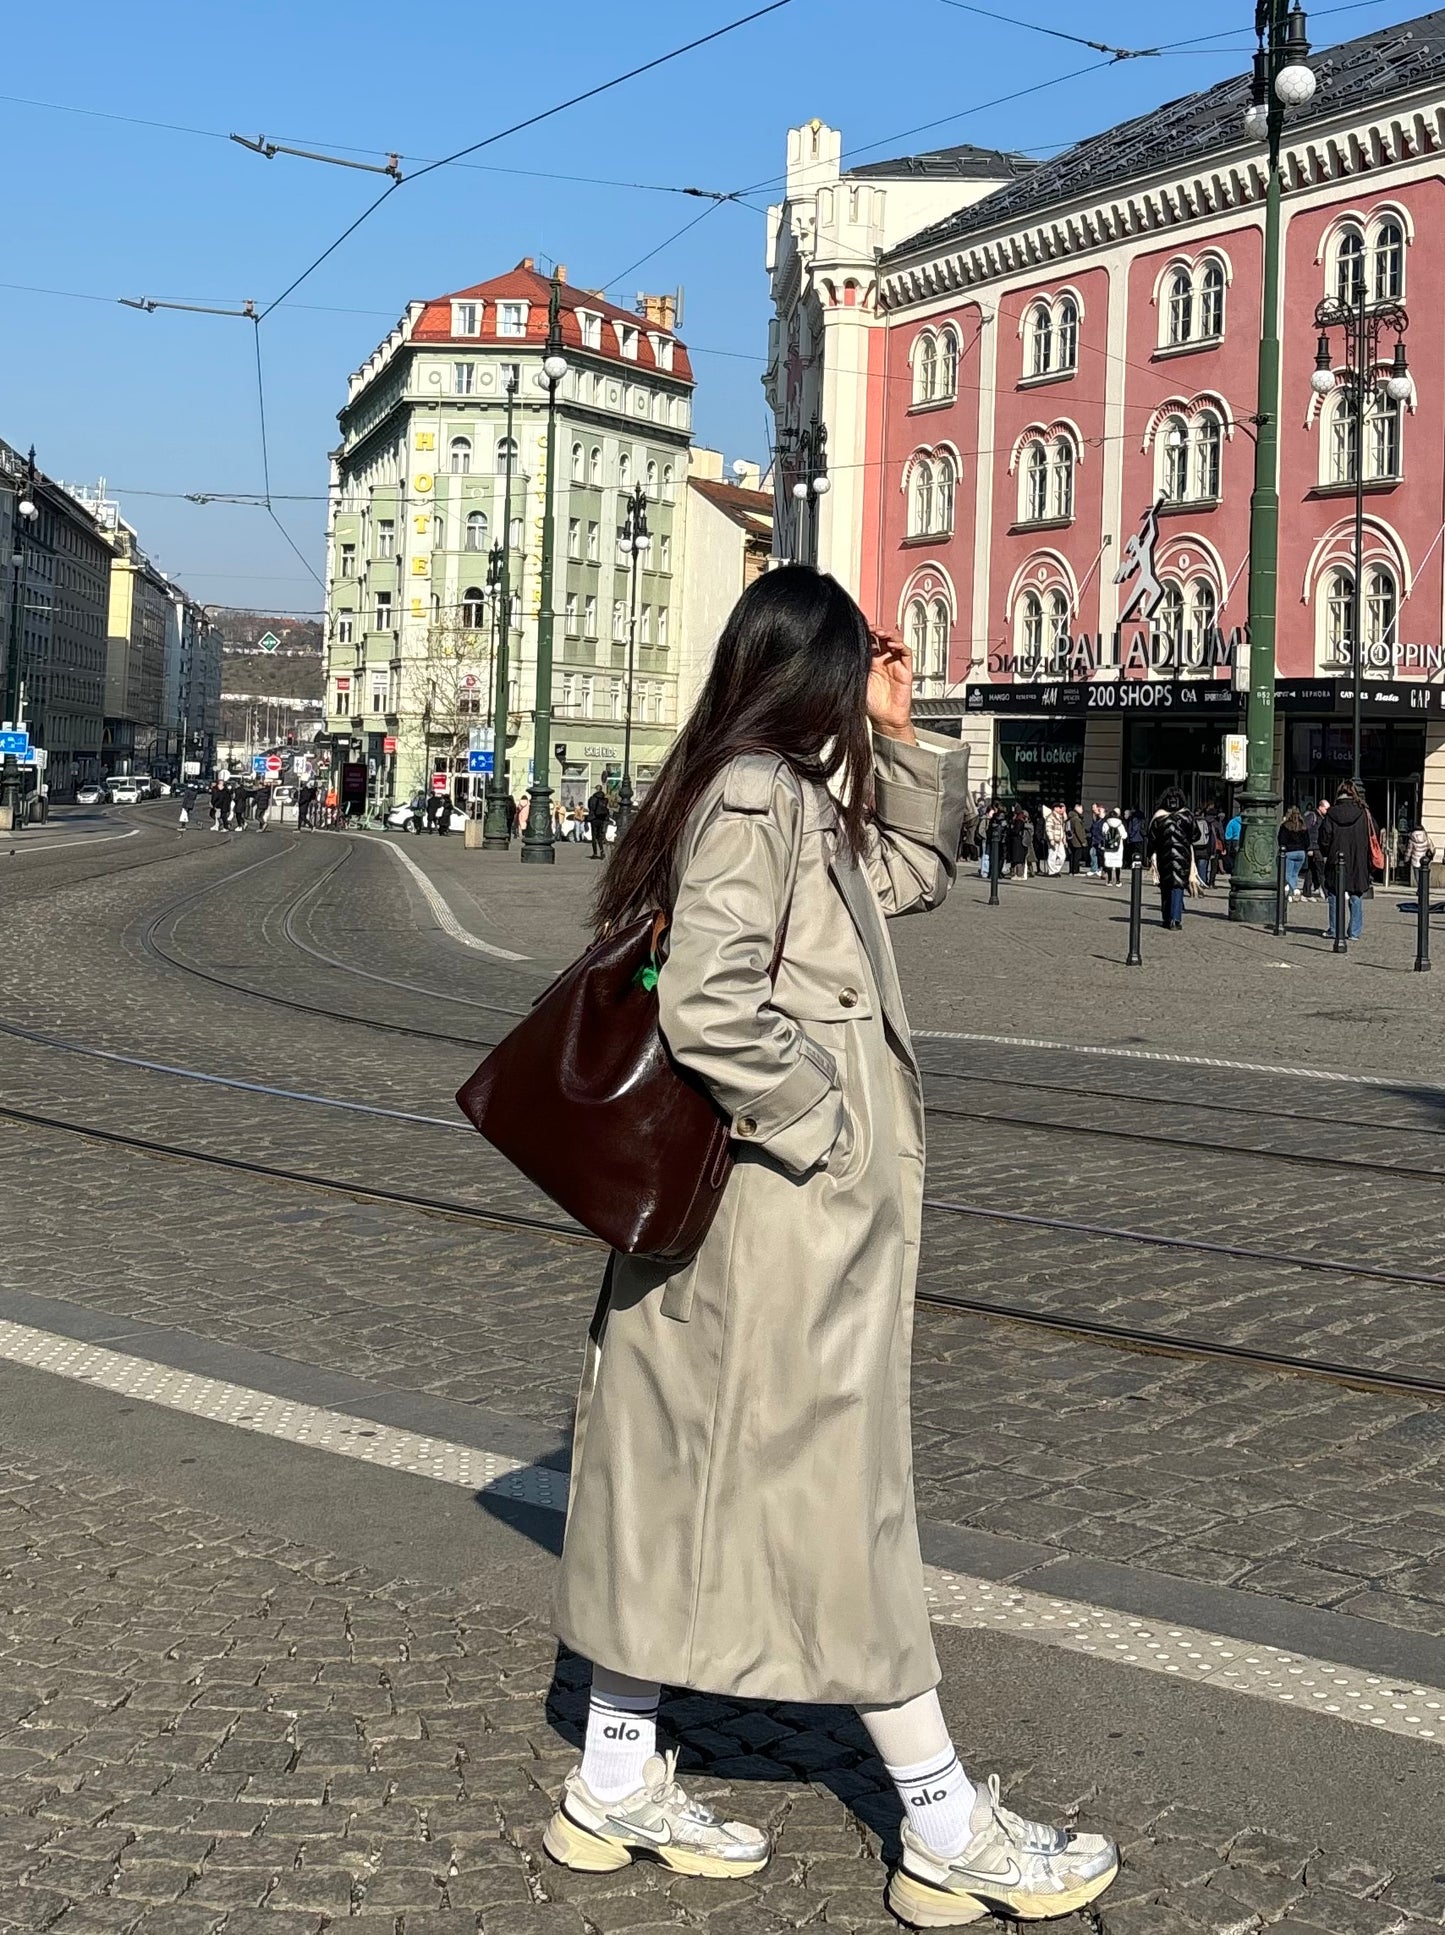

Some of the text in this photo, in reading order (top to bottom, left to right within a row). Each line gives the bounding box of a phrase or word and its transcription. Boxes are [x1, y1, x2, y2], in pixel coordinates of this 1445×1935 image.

[411, 432, 435, 617] HOTEL
[1053, 627, 1242, 670] PALLADIUM
[1338, 639, 1445, 668] SHOPPIN
[1088, 684, 1172, 706] 200 SHOPS
[1301, 690, 1331, 698] SEPHORA
[1410, 689, 1431, 709] GAP
[1015, 745, 1078, 764] Foot Locker
[603, 1722, 640, 1741] alo
[911, 1789, 947, 1806] alo
